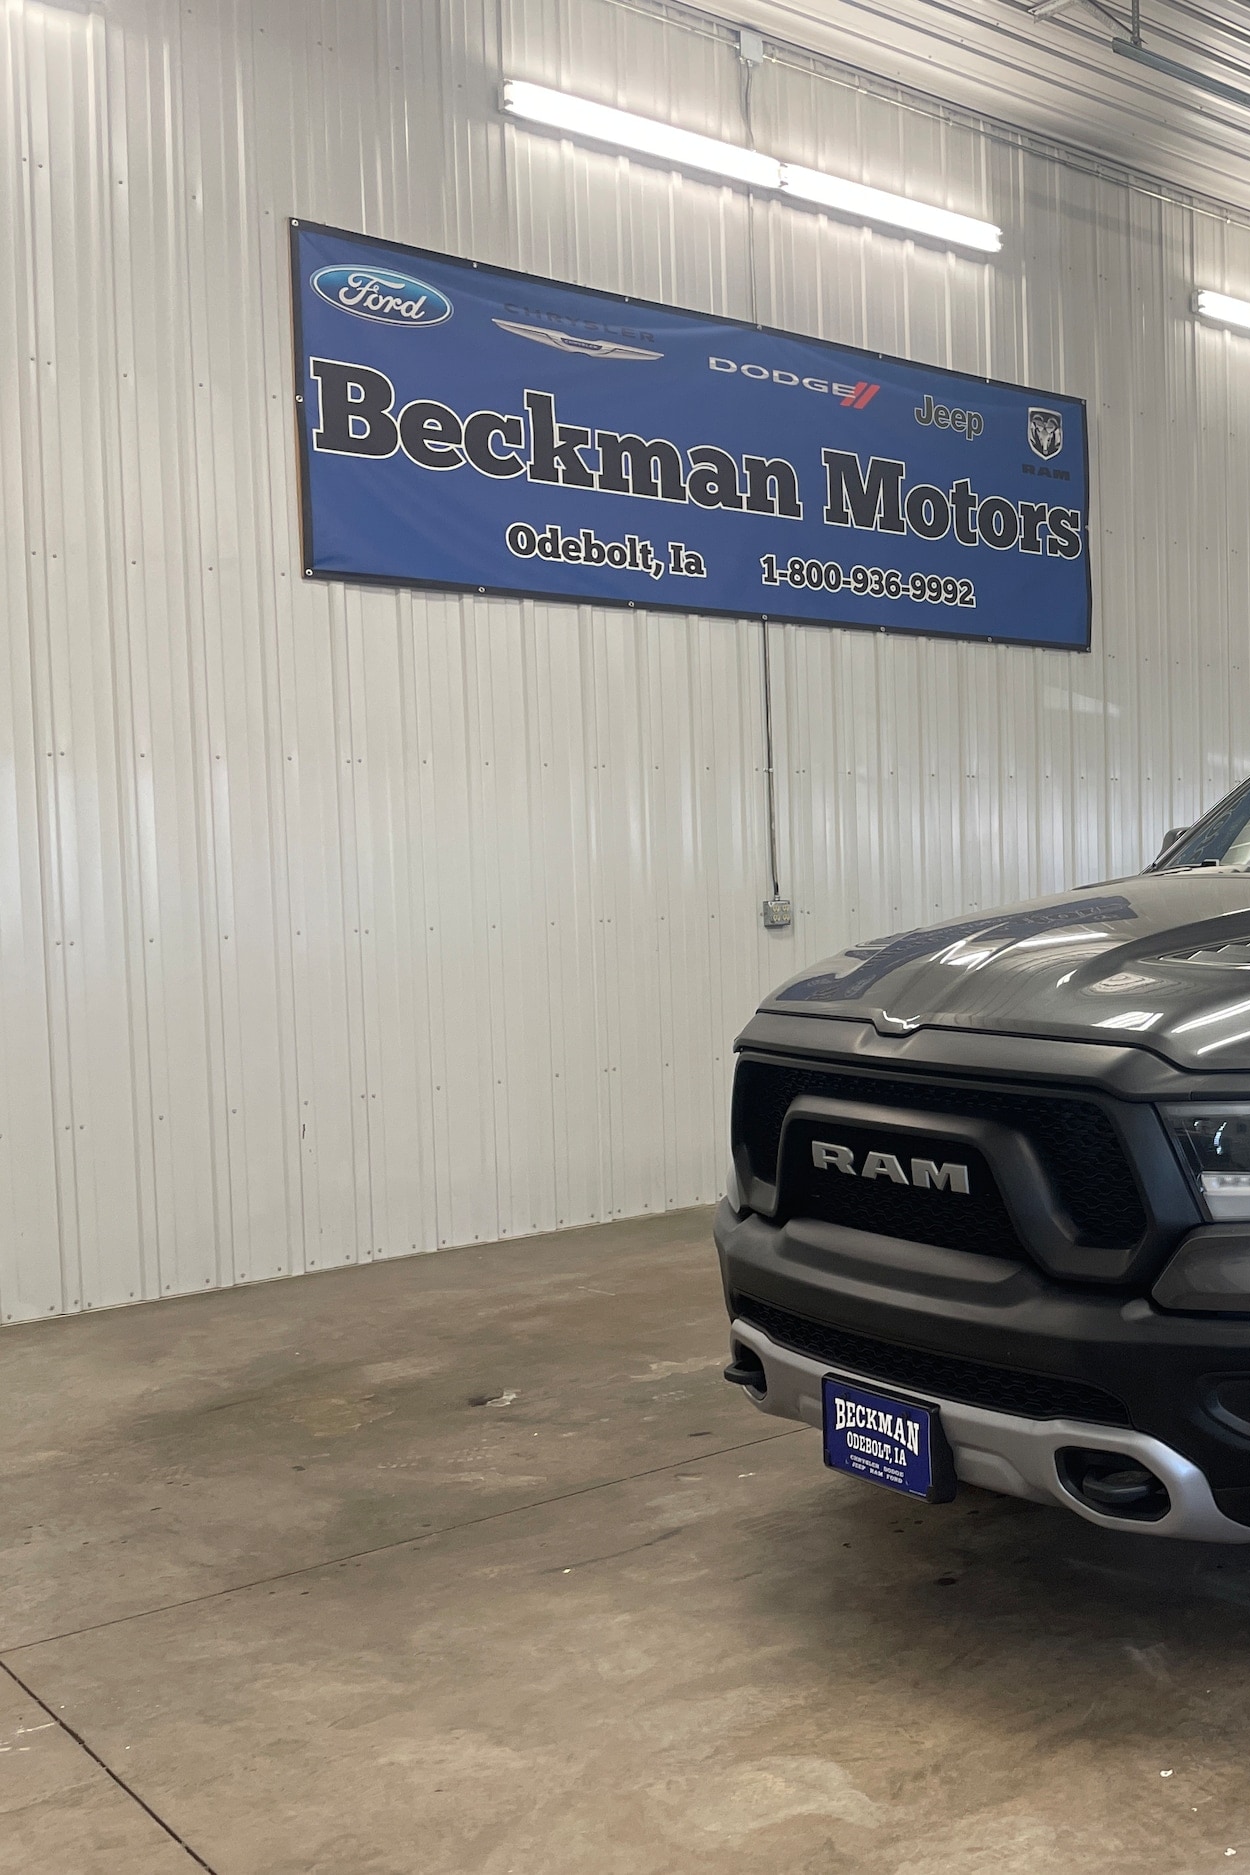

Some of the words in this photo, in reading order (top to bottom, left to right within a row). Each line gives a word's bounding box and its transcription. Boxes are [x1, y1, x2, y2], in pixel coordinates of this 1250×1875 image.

[338, 272, 427, 321] Ford
[503, 303, 655, 343] CHRYSLER
[708, 356, 857, 398] DODGE
[914, 395, 984, 441] Jeep
[309, 356, 803, 520] Beckman
[821, 447, 1082, 559] Motors
[1021, 464, 1070, 481] RAM
[506, 522, 662, 580] Odebolt,
[669, 542, 707, 578] Ia
[760, 554, 976, 608] 1-800-936-9992
[812, 1140, 970, 1194] RAM
[834, 1397, 920, 1457] BECKMAN
[846, 1431, 893, 1464] ODEBOLT,
[894, 1445, 907, 1466] IA
